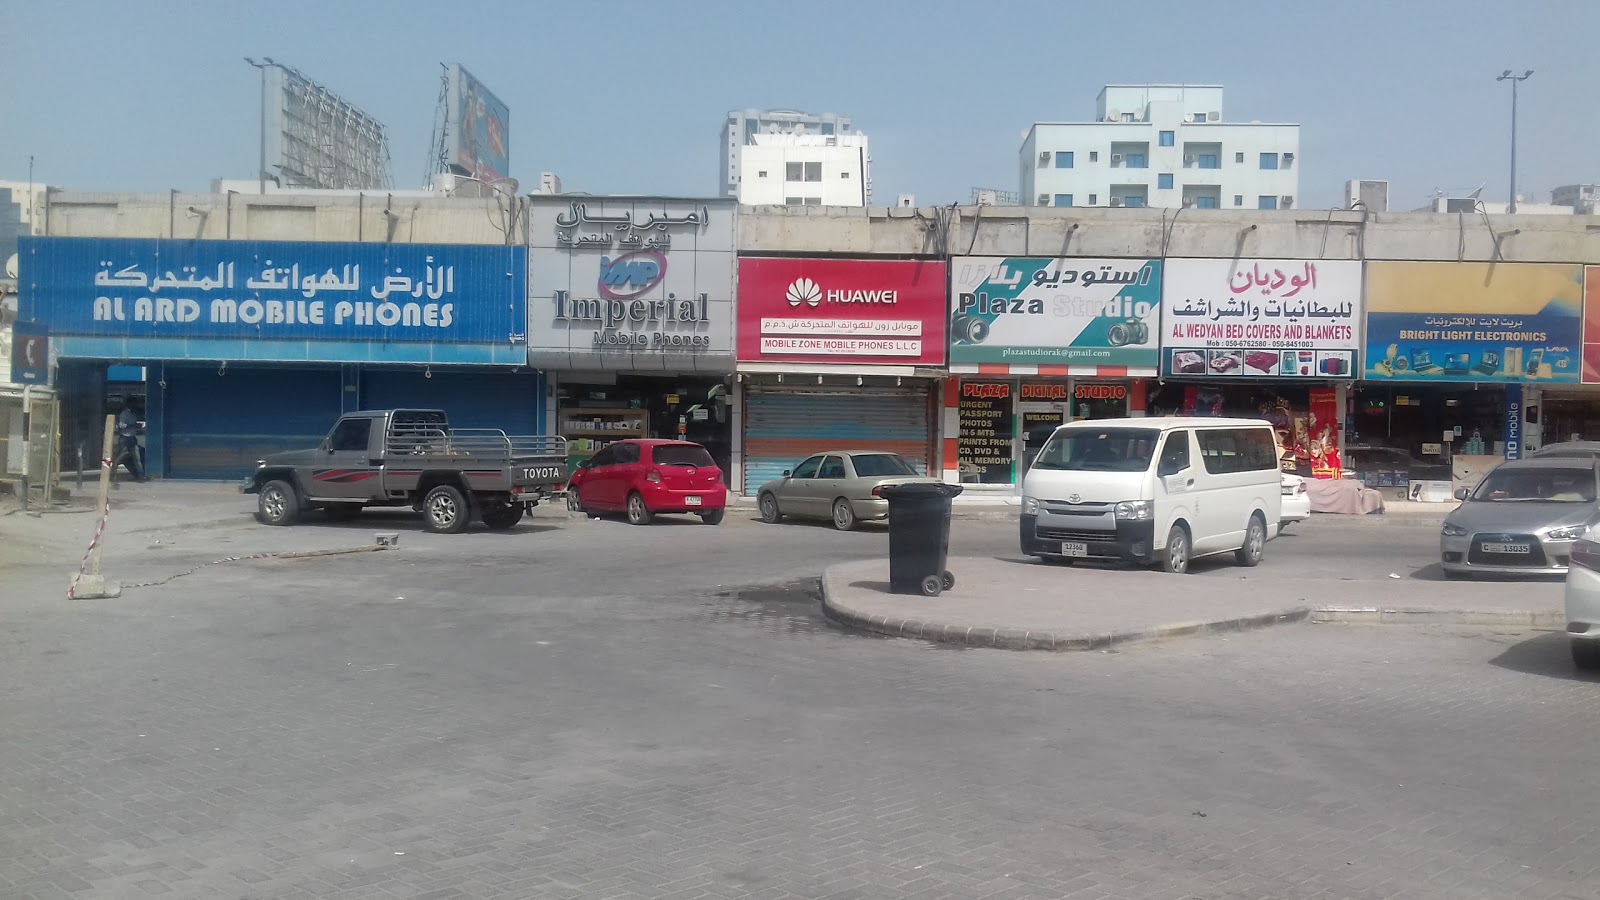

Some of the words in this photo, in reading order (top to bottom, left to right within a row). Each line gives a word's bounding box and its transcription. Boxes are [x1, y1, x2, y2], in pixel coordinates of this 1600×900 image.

[557, 231, 614, 247] المتحركة
[619, 233, 671, 248] للهواتف
[94, 260, 234, 292] المتحركة
[247, 259, 359, 298] للهواتف
[371, 255, 453, 299] الأرض
[958, 264, 1023, 290] بلازا
[1032, 266, 1152, 288] استوديو
[1230, 261, 1317, 298] الوديان
[827, 288, 898, 304] HUAWEI
[93, 296, 126, 321] AL
[134, 298, 201, 322] ARD
[210, 299, 324, 324] MOBILE
[334, 301, 454, 328] PHONES
[554, 290, 710, 330] Imperial
[958, 292, 1044, 314] Plaza
[1053, 294, 1151, 318] Studio
[1172, 297, 1260, 321] والشراشف
[1264, 300, 1353, 323] للبطانيات
[800, 320, 836, 330] المتحركة
[838, 321, 874, 331] للهواتف
[874, 322, 890, 331] زون
[891, 321, 919, 332] موبايل
[1480, 318, 1500, 328] لايت
[1500, 319, 1523, 329] بريت
[593, 331, 648, 346] Mobile
[652, 332, 710, 346] Phones
[1172, 324, 1184, 338] AL
[1186, 324, 1224, 338] WEDYAN
[1226, 324, 1244, 339] BED
[1246, 324, 1282, 339] COVERS
[1284, 324, 1302, 339] AND
[1305, 325, 1352, 340] BLANKETS
[1400, 330, 1440, 340] BRIGHT
[1441, 331, 1472, 340] LIGHT
[1474, 332, 1546, 342] ELECTRONICS
[764, 340, 796, 348] MOBILE
[798, 340, 822, 348] ZONE
[824, 340, 856, 349] MOBILE
[858, 341, 894, 350] PHONES
[896, 342, 917, 350] L.L.C
[1225, 340, 1266, 348] 050-6762580
[1002, 348, 1111, 358] plazastudiorak@gmail.com
[964, 384, 1010, 398] PLAZA
[1021, 384, 1066, 400] DIGITAL
[1074, 385, 1127, 399] STUDIO
[960, 401, 992, 409] URGENT
[960, 410, 1003, 418] PASSPORT
[960, 419, 992, 427] PHOTOS
[959, 438, 988, 446] PRINTS
[959, 456, 974, 464] ALL
[523, 467, 559, 478] TOYOTA
